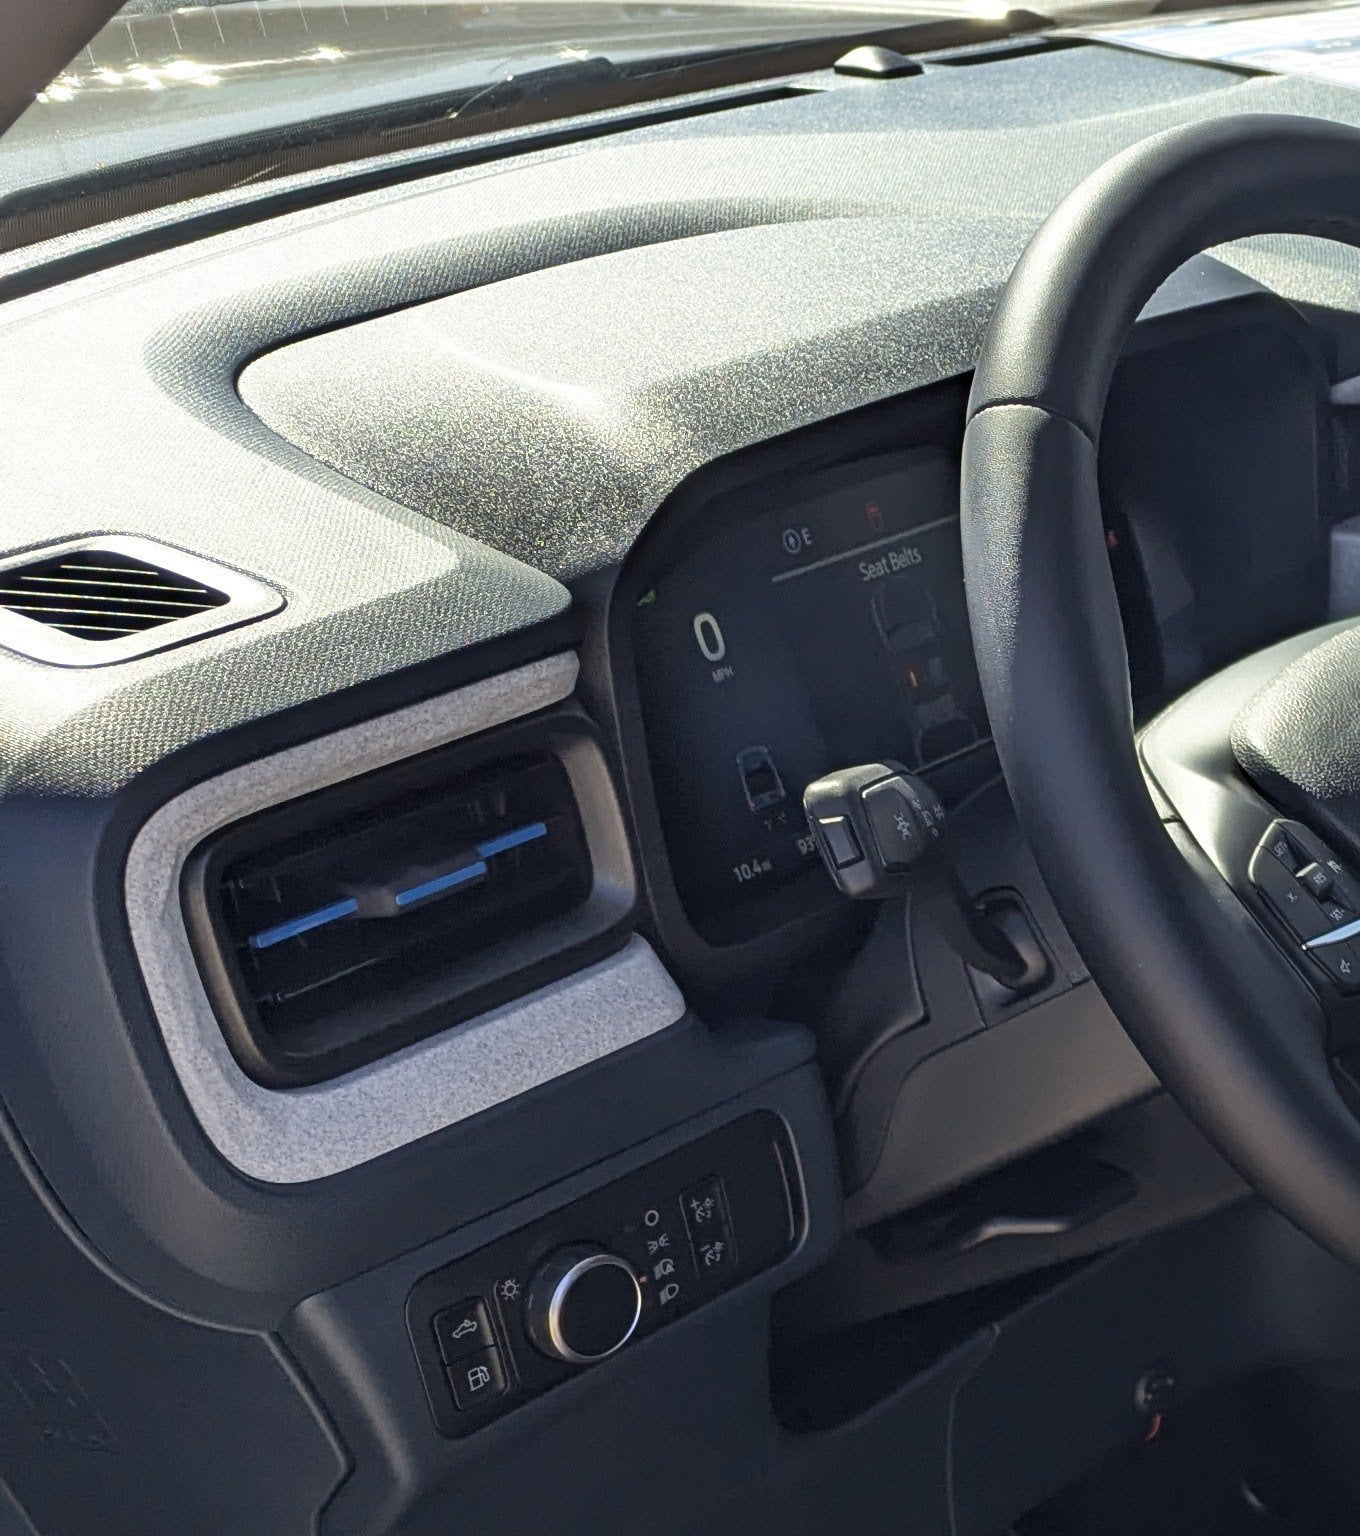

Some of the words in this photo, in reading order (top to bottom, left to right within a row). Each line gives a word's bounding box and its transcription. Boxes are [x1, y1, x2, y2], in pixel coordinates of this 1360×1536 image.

[858, 555, 890, 583] Seat
[888, 547, 922, 572] Belts
[692, 611, 726, 663] 0
